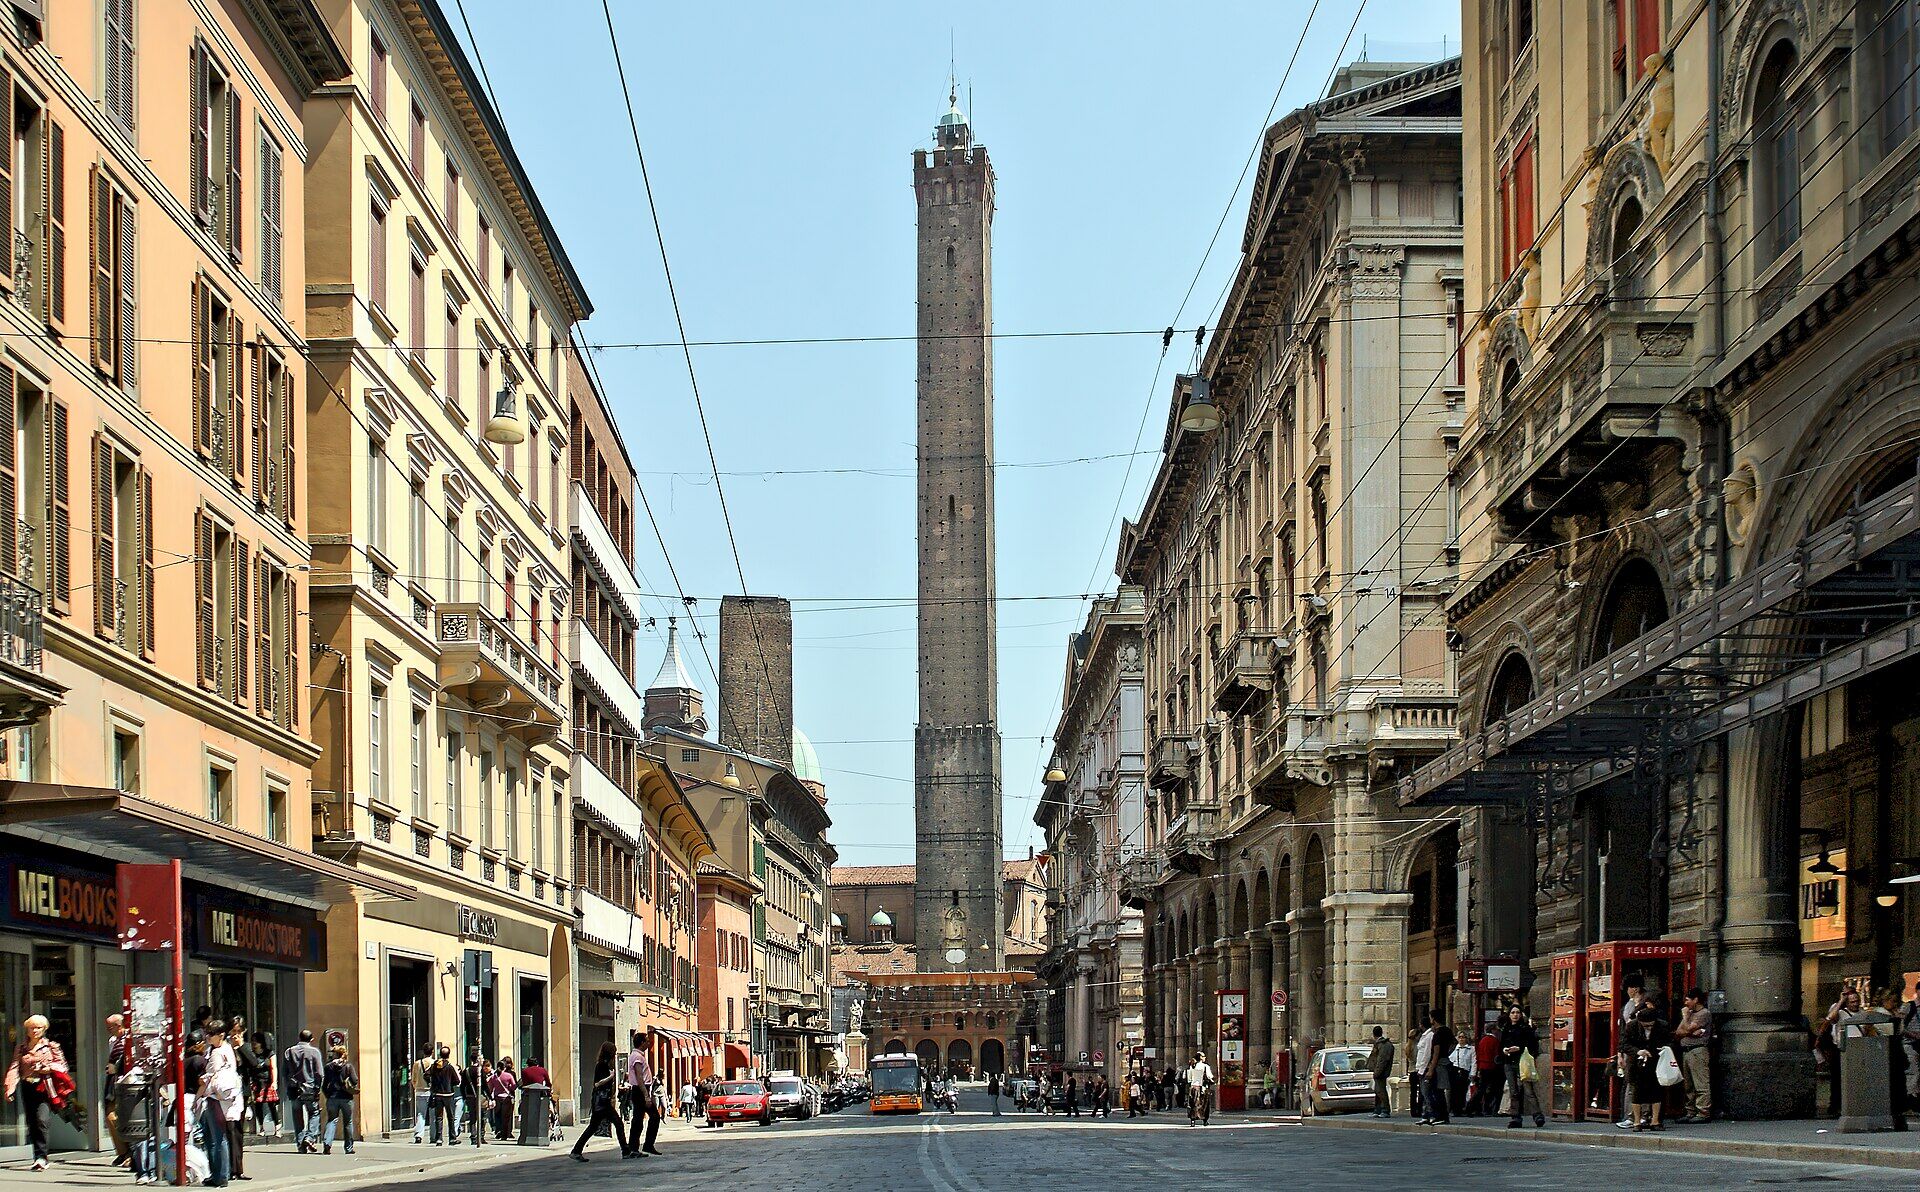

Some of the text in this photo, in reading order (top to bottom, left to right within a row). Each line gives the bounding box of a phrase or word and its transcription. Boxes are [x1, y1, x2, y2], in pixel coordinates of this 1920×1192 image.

[18, 869, 117, 928] MELBOOKS
[212, 909, 302, 958] MELBOOKSTORE
[1627, 946, 1683, 954] TELEFONO
[1080, 1052, 1088, 1061] P
